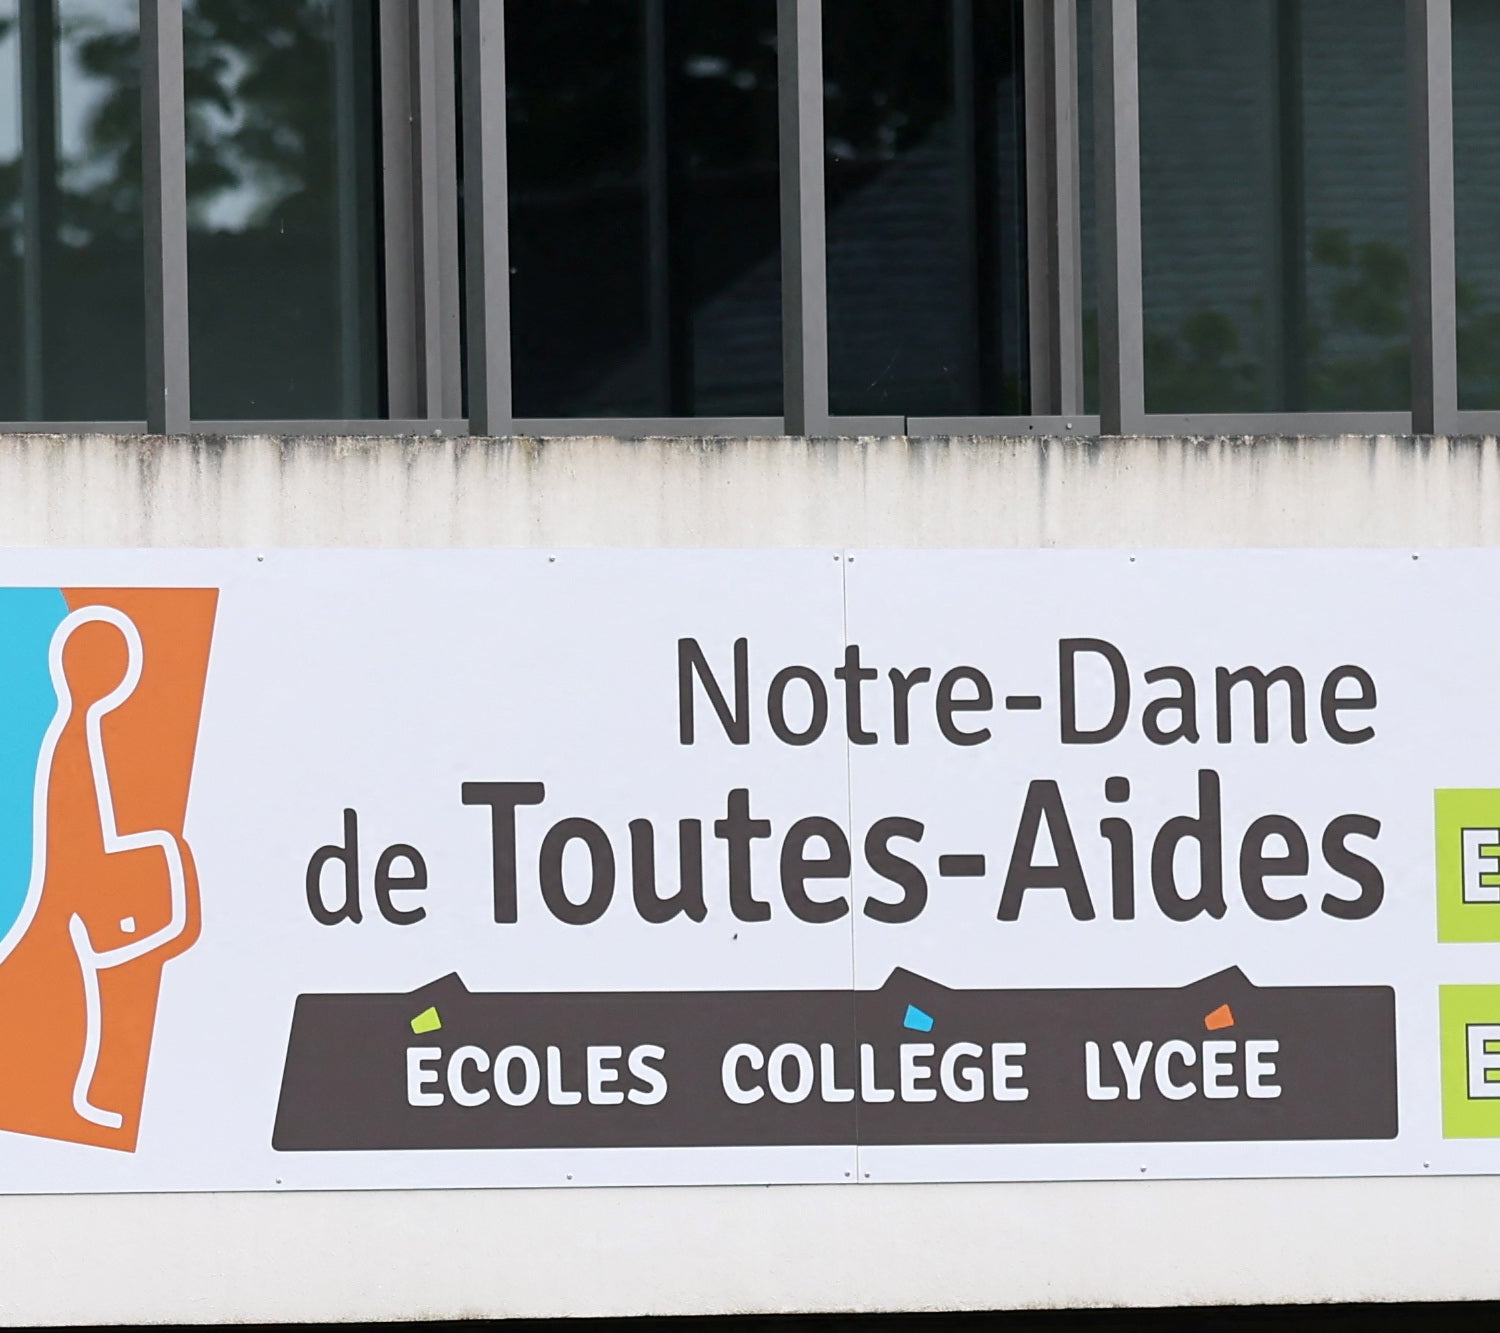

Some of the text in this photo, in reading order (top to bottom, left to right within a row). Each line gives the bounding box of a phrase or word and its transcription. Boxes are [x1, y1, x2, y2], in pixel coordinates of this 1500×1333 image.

[677, 637, 1378, 747] Notre-Dame
[305, 767, 1385, 926] de Toutes-Aides
